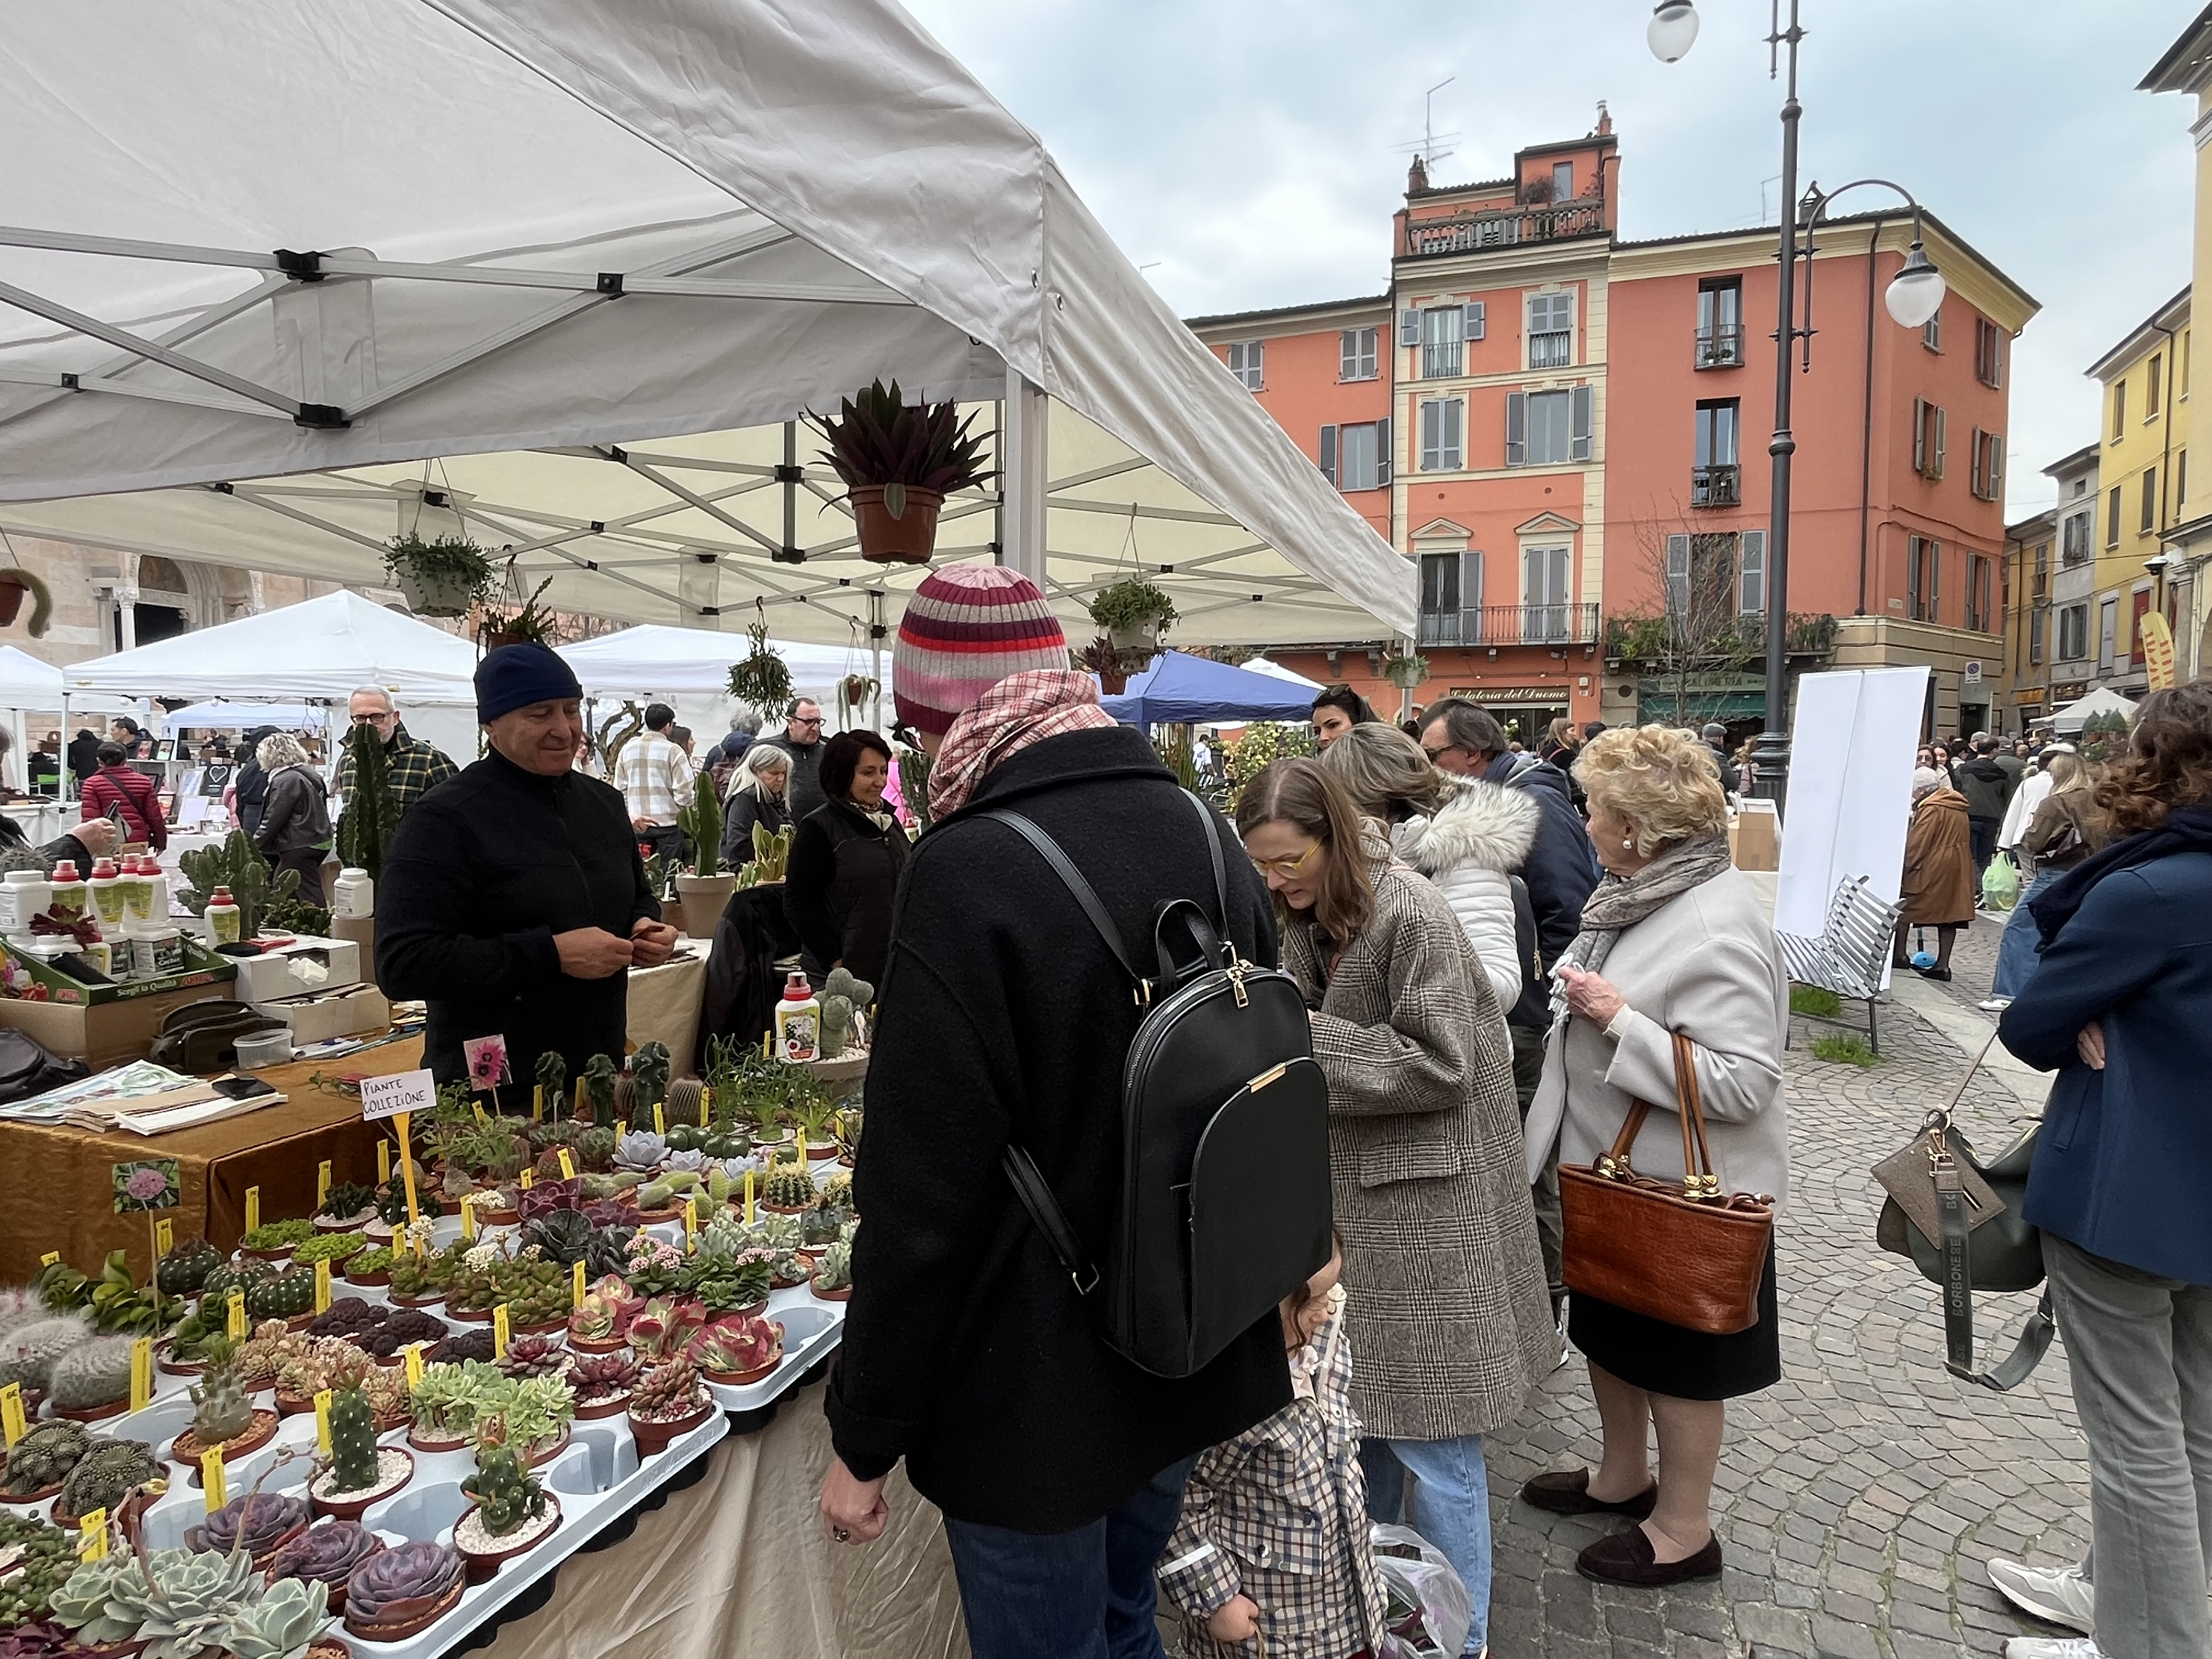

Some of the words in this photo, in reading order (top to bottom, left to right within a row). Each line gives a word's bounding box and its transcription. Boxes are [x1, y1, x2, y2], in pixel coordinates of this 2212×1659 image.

[1504, 689, 1524, 698] del
[1525, 689, 1567, 698] Duomo
[1949, 1238, 1964, 1317] BORBONESE
